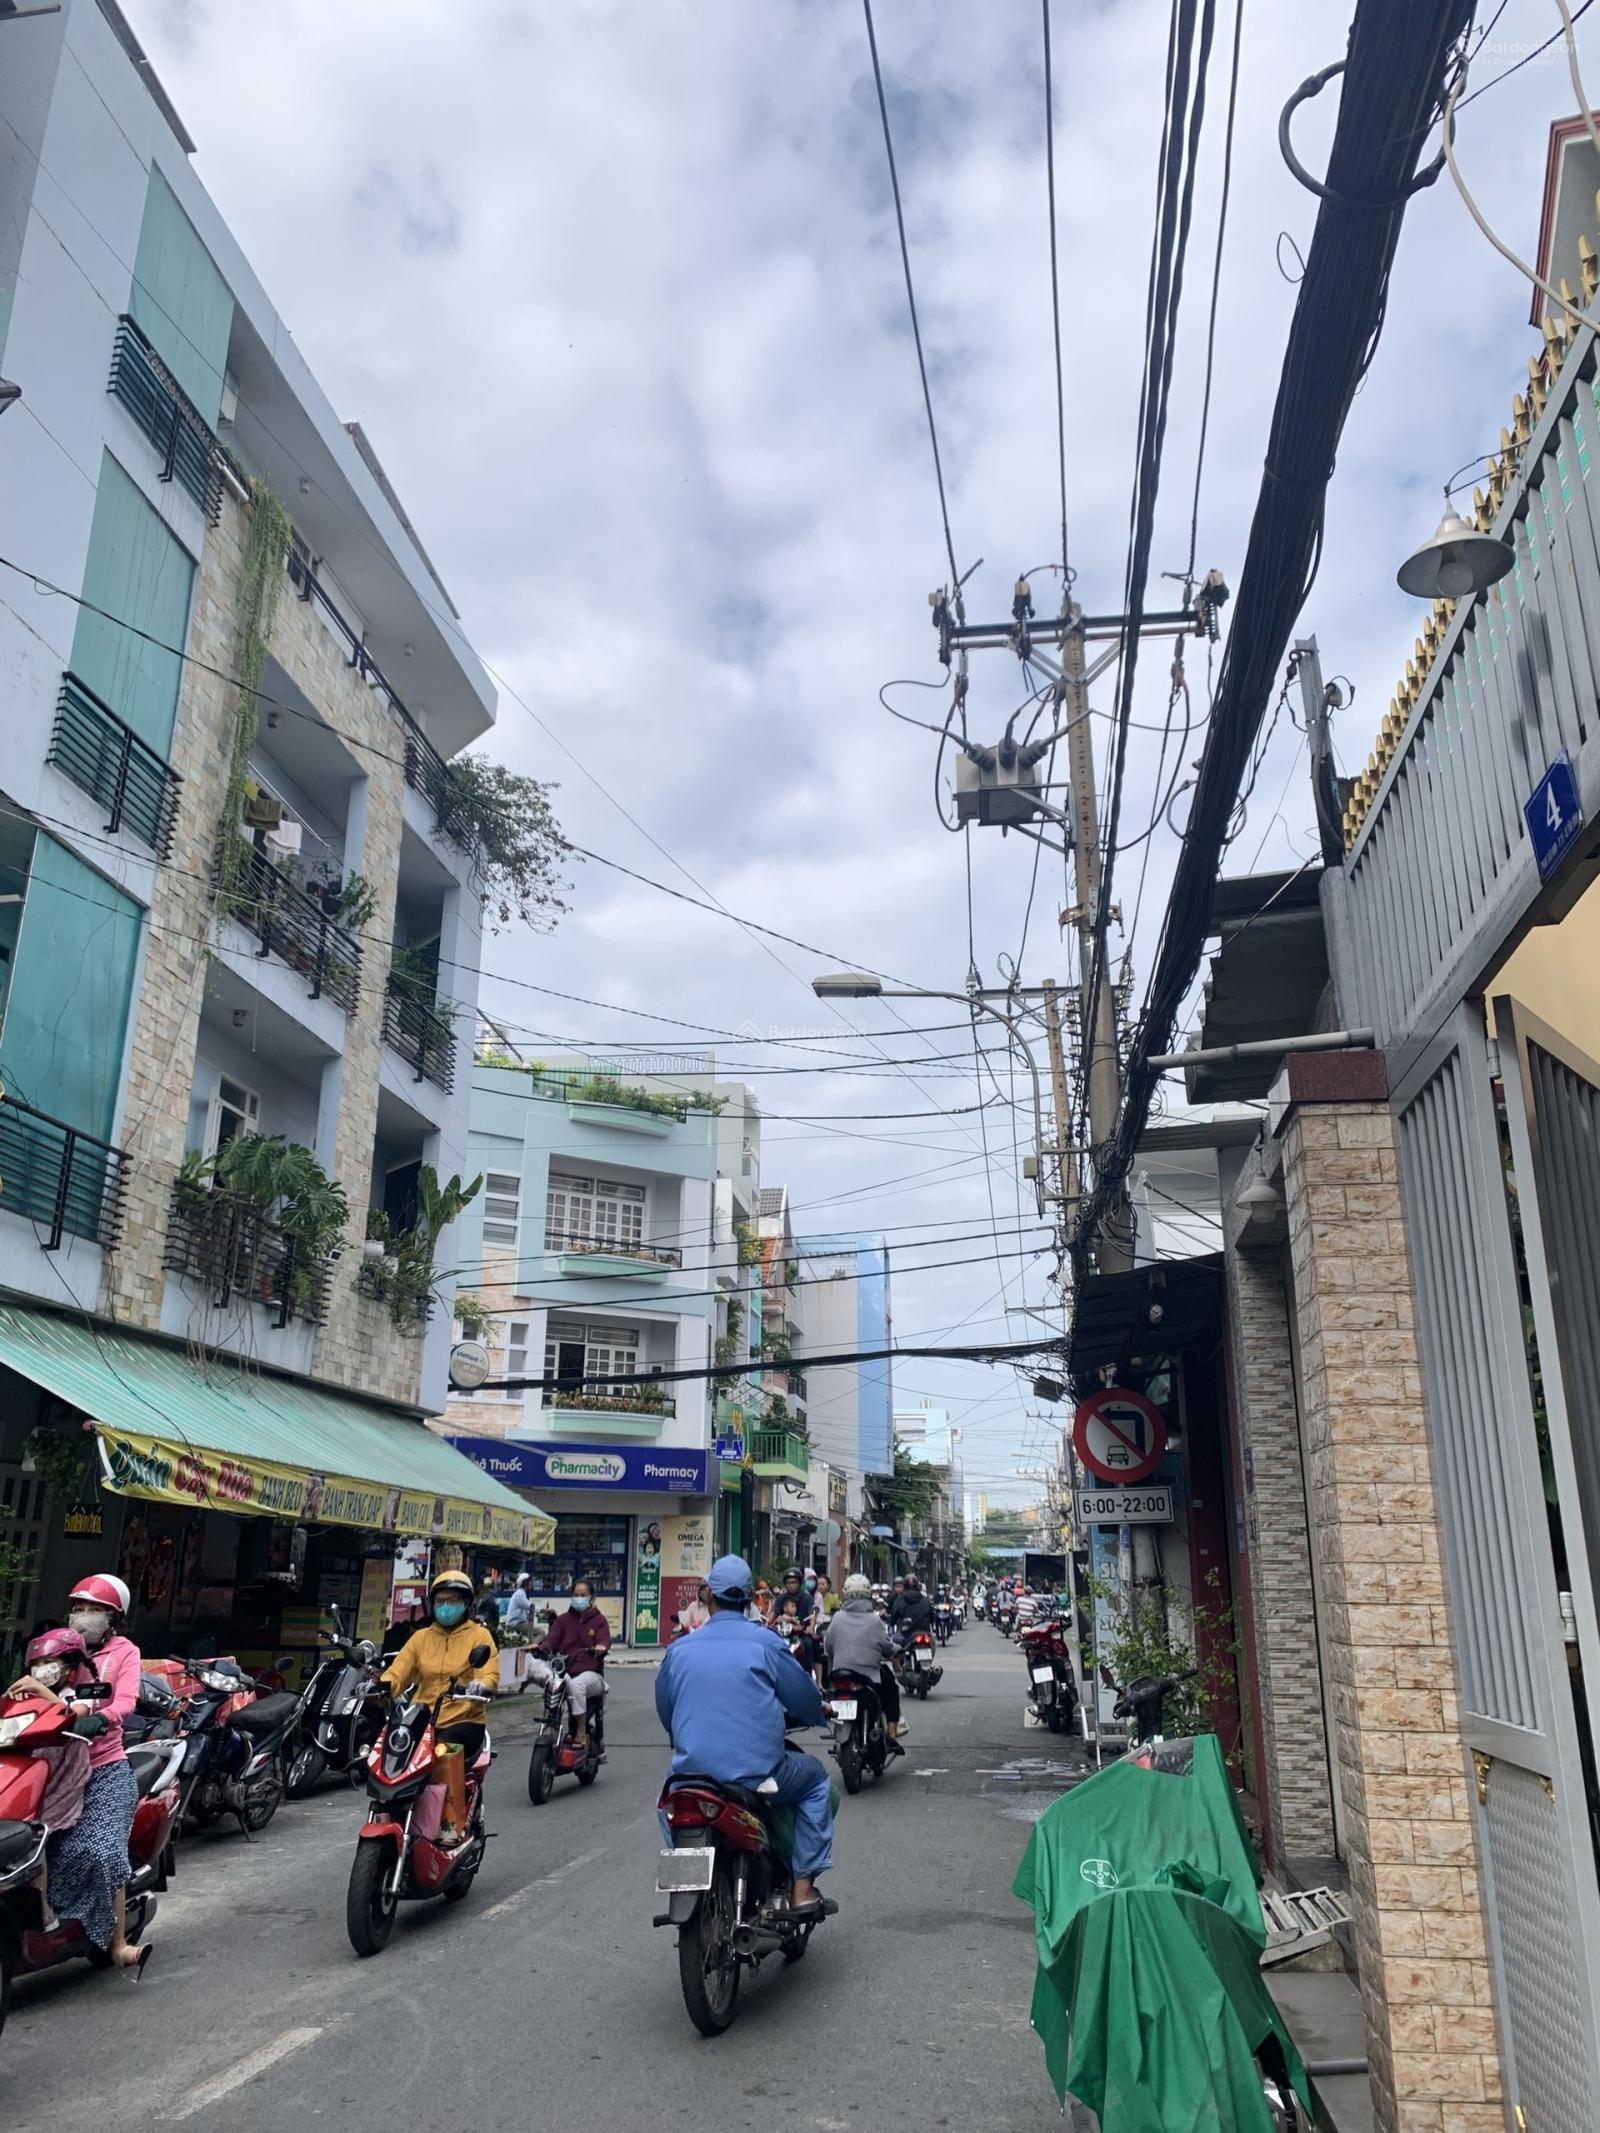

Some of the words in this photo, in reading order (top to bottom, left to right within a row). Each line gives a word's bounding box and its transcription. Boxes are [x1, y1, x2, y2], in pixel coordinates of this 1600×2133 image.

[1547, 781, 1563, 832] 4
[109, 1439, 172, 1490] Quán
[489, 1456, 523, 1472] Thuốc
[551, 1458, 620, 1478] Pharmacity
[644, 1464, 699, 1481] Pharmacy
[1082, 1497, 1165, 1514] 6:00-22:00
[678, 1533, 705, 1542] OMEGA
